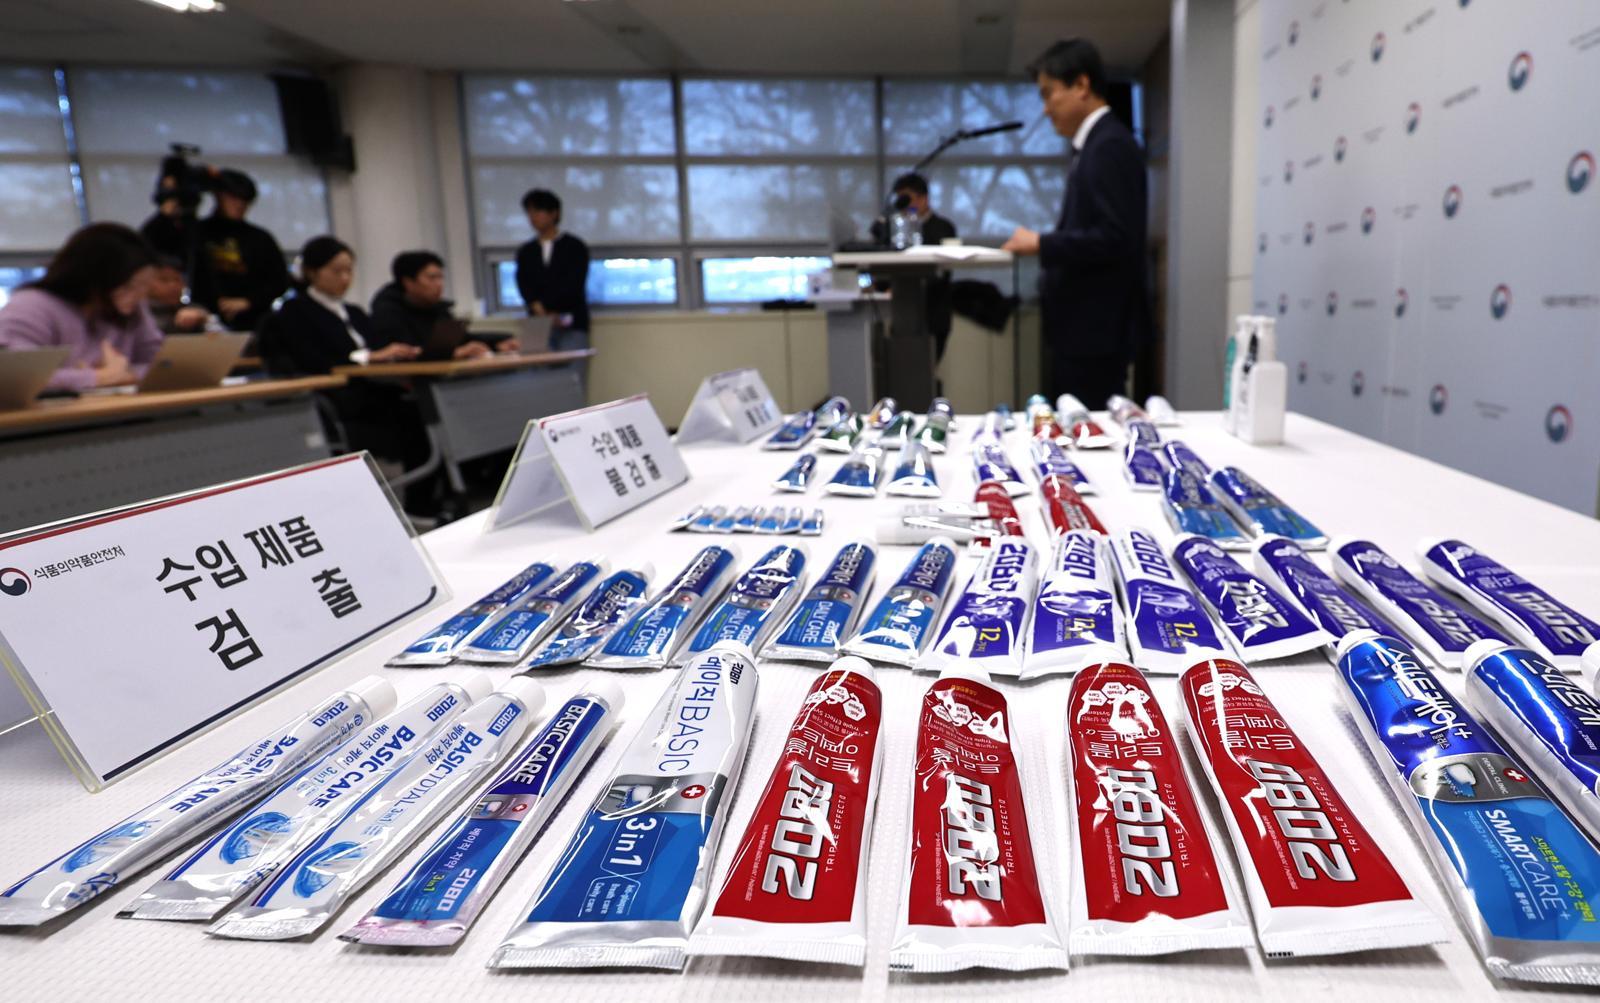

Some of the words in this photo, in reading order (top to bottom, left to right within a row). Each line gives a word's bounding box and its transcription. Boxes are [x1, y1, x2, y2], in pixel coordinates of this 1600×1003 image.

[590, 430, 620, 459] 수입
[33, 544, 126, 581] 식품의약품안전처
[156, 539, 248, 601] 수입
[244, 515, 325, 571] 제품
[988, 543, 1028, 592] 2080
[1064, 533, 1096, 579] 2080
[1130, 531, 1175, 580] 2080
[194, 608, 264, 671] 검
[312, 566, 362, 619] 출
[813, 601, 833, 618] DAILY
[1503, 592, 1596, 644] 2080
[628, 629, 655, 654] CARE
[802, 620, 824, 643] CARE
[980, 627, 1001, 641] 12
[1174, 622, 1199, 637] 12
[312, 701, 349, 727] 2080
[426, 694, 458, 722] 2080
[493, 707, 516, 733] 2080
[825, 712, 841, 725] Effect
[1224, 713, 1287, 729] 이펙트
[360, 724, 389, 750] 베이직
[441, 724, 466, 749] 베이직
[548, 705, 586, 742] BASIC
[843, 721, 859, 731] Triple
[359, 725, 416, 773] BASIC
[803, 726, 859, 755] 이펙트
[1088, 742, 1162, 759] 트리플
[1220, 730, 1295, 750] 트리플
[344, 749, 364, 766] 케어
[425, 746, 444, 764] 치약
[513, 744, 555, 785] CARE
[786, 737, 858, 774] 트리플
[314, 771, 364, 808] CARE
[1482, 757, 1499, 777] DENTAL
[1494, 775, 1511, 795] CLINIC
[762, 763, 834, 901] 2080
[1106, 766, 1181, 898] 2080
[1246, 758, 1358, 882] 2080
[456, 827, 482, 851] 베이직
[1175, 827, 1190, 868] TRIPLE
[1336, 817, 1361, 853] TRIPLE
[444, 852, 464, 868] 치약
[825, 832, 840, 872] TRIPLE
[999, 828, 1015, 875] TRIPLE
[436, 868, 478, 911] 2080
[1531, 836, 1561, 863] 스마트한
[1563, 879, 1583, 898] 구강
[1574, 901, 1597, 922] 관리
[585, 898, 596, 913] care
[600, 899, 611, 914] care
